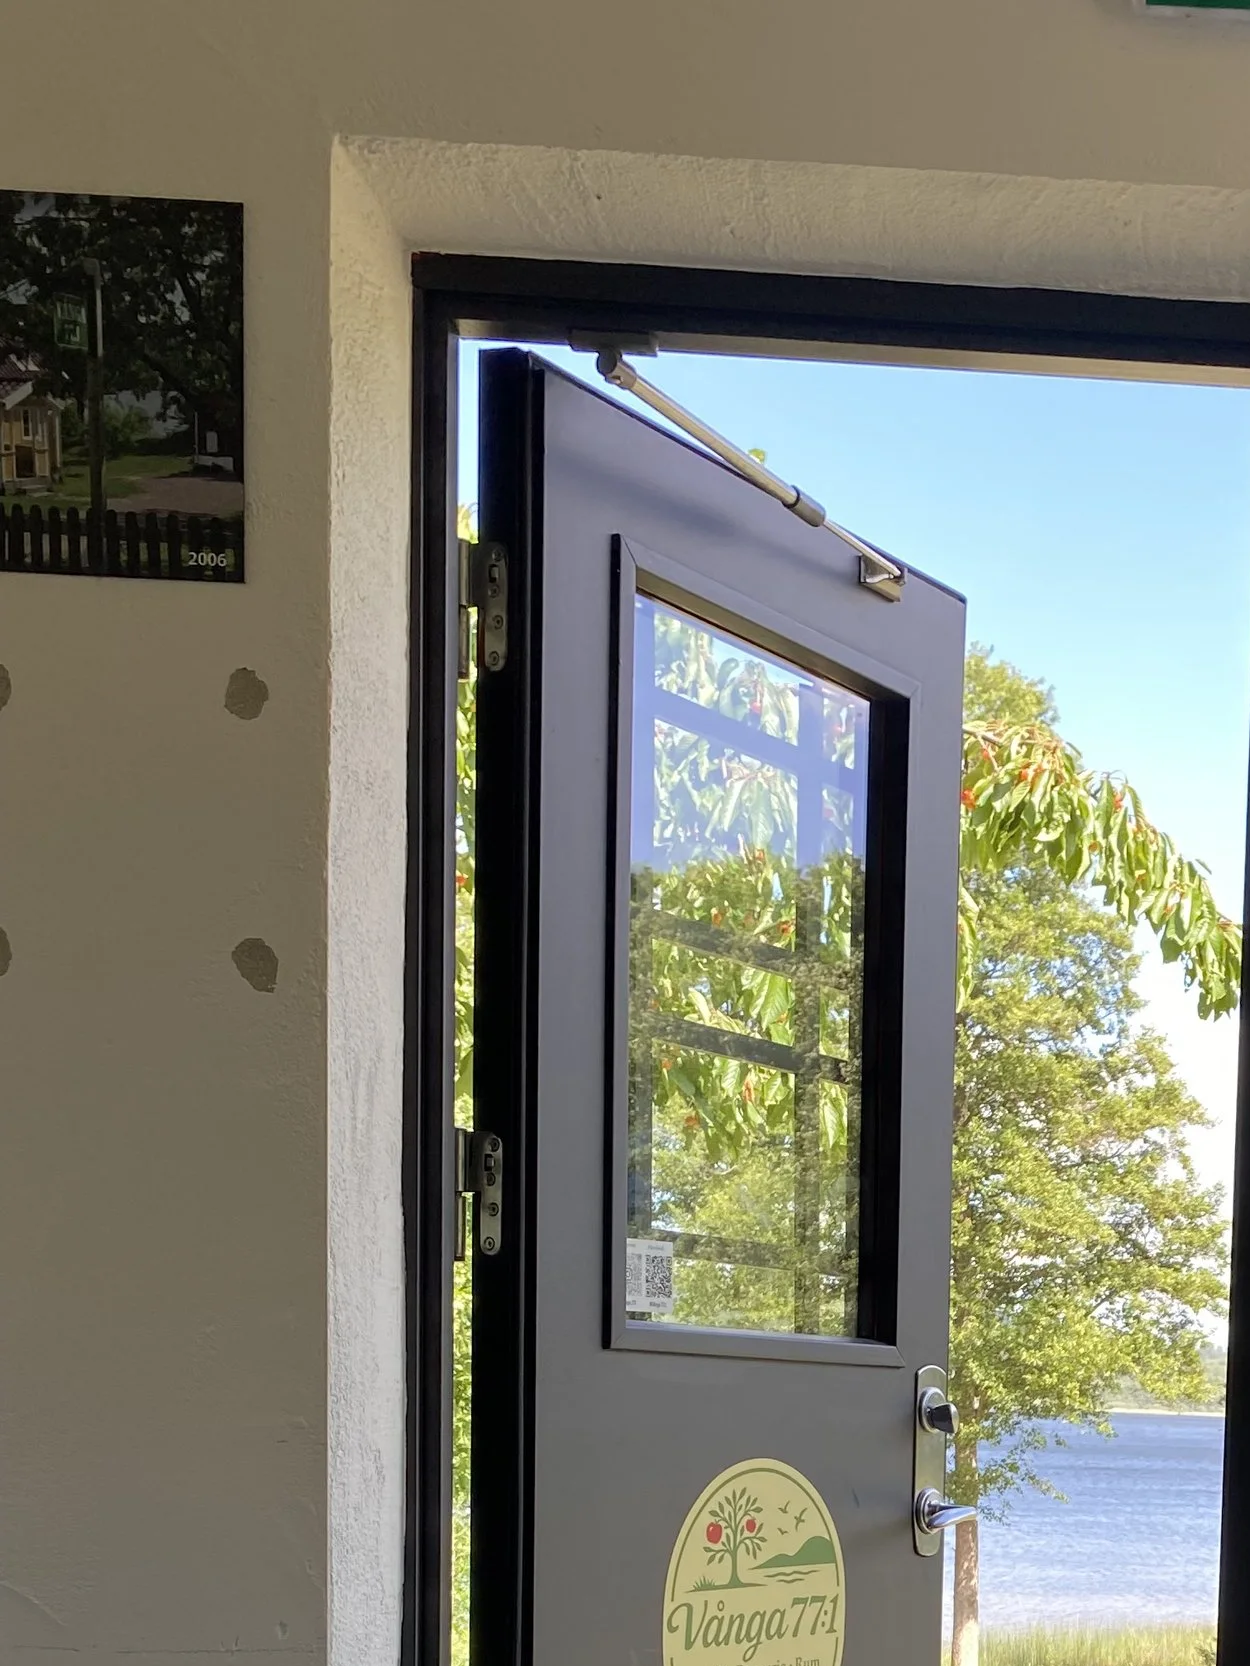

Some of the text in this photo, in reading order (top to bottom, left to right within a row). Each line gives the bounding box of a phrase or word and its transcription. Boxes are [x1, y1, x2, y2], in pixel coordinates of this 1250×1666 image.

[188, 551, 228, 567] 2006
[666, 1593, 839, 1663] Vånga 77:1
